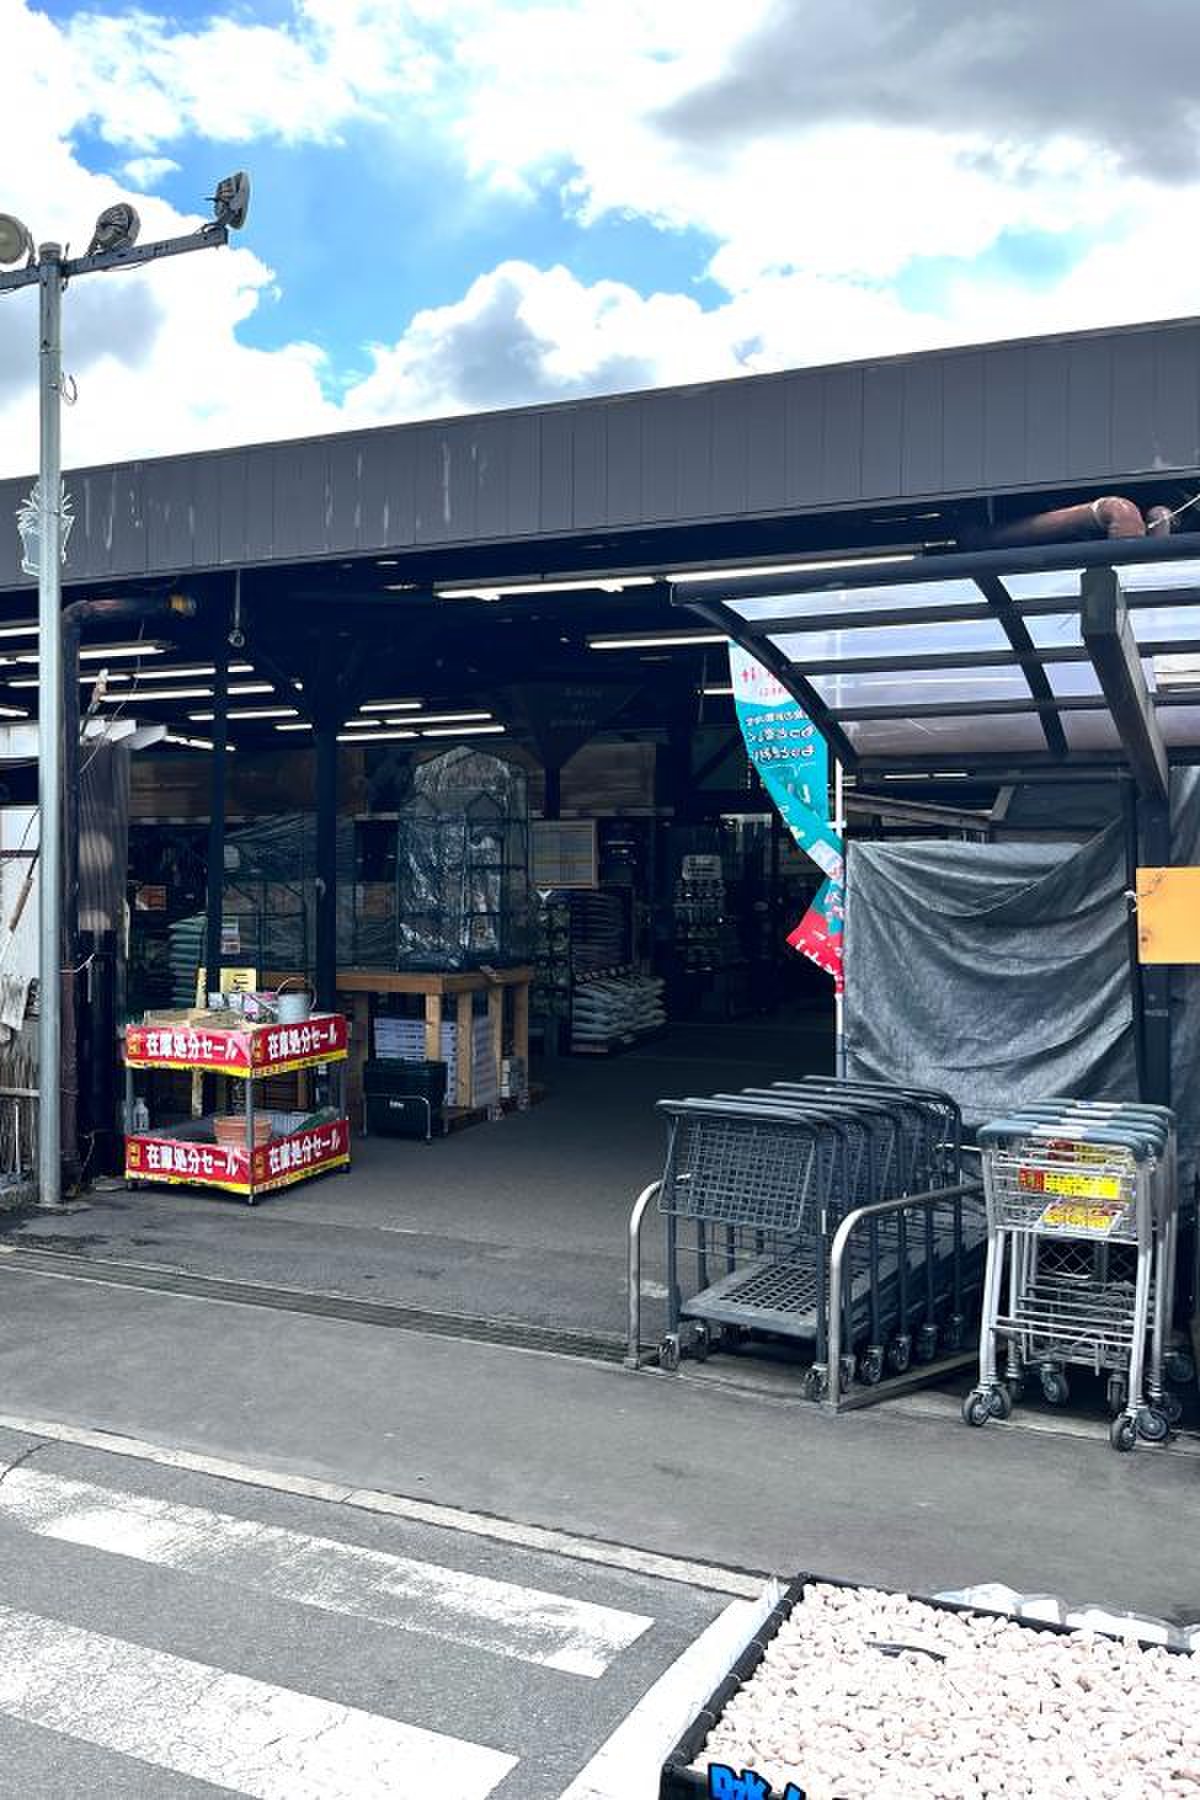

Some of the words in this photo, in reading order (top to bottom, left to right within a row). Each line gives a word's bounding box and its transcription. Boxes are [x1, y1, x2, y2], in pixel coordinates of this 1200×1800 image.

[146, 1033, 238, 1059] 在庫処分セール
[268, 1023, 338, 1060] 在庫処分セール
[146, 1145, 239, 1175] 在庫処分セール
[269, 1130, 341, 1174] 在庫処分セール
